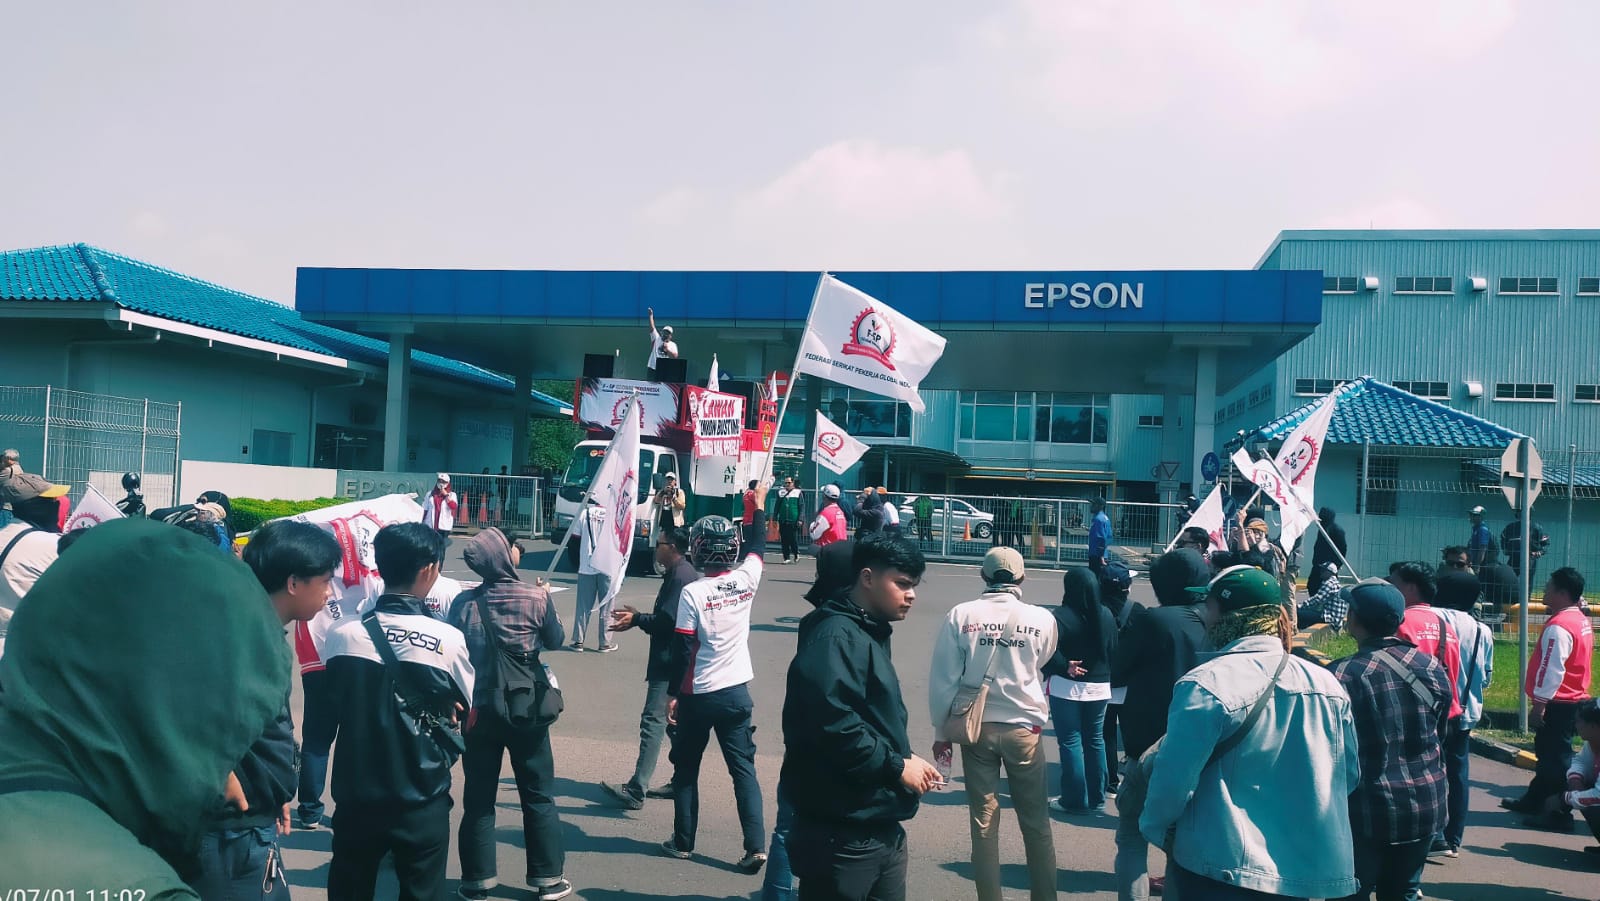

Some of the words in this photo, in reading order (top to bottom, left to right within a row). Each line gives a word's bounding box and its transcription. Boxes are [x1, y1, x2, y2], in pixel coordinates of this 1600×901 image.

[1024, 282, 1144, 309] EPSON
[805, 352, 832, 366] FEDERASI
[832, 360, 855, 372] SERIKAT
[855, 367, 879, 379] PEKERJA
[879, 374, 898, 385] GLOBAL
[702, 399, 736, 418] LAWAN
[982, 623, 1005, 632] YOU
[1016, 625, 1041, 638] LIFE
